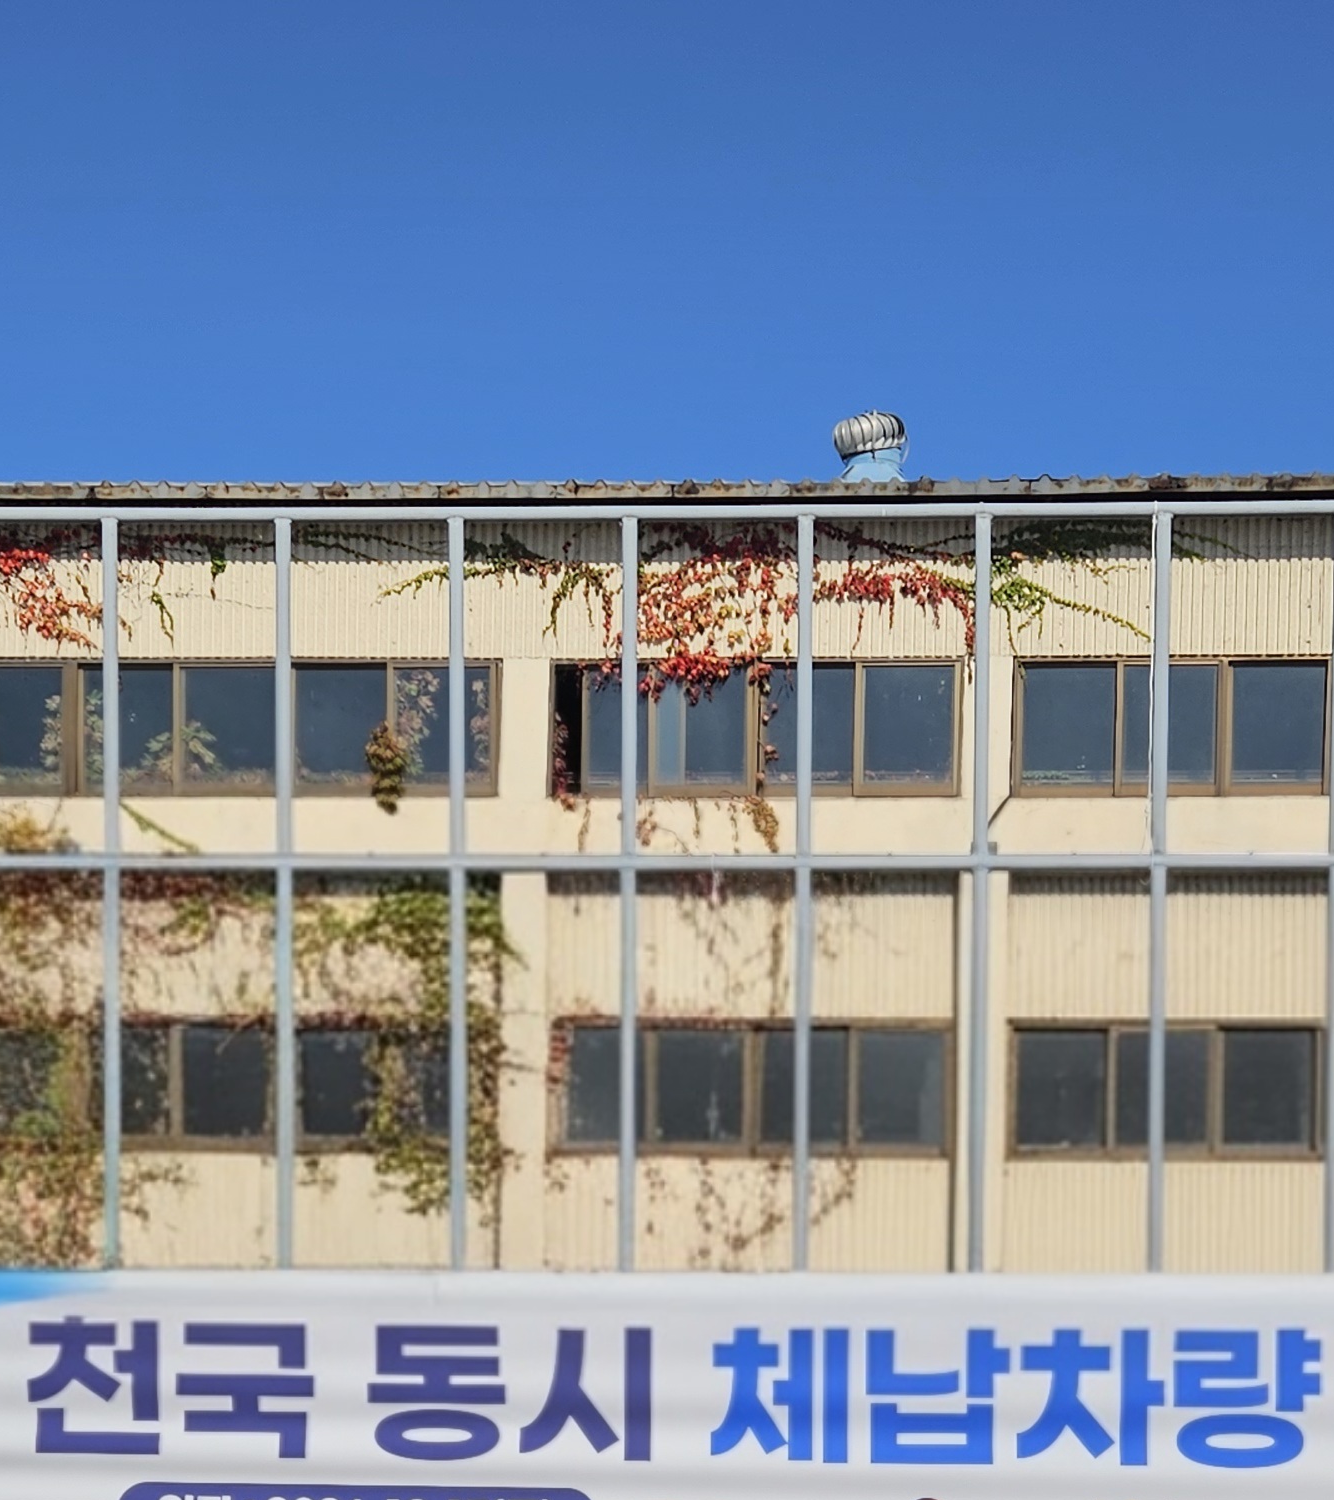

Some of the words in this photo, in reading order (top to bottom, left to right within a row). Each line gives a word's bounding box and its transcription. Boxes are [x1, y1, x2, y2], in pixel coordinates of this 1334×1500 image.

[28, 1316, 314, 1458] 천국
[368, 1325, 651, 1461] 동시
[711, 1328, 1321, 1468] 체납차량
